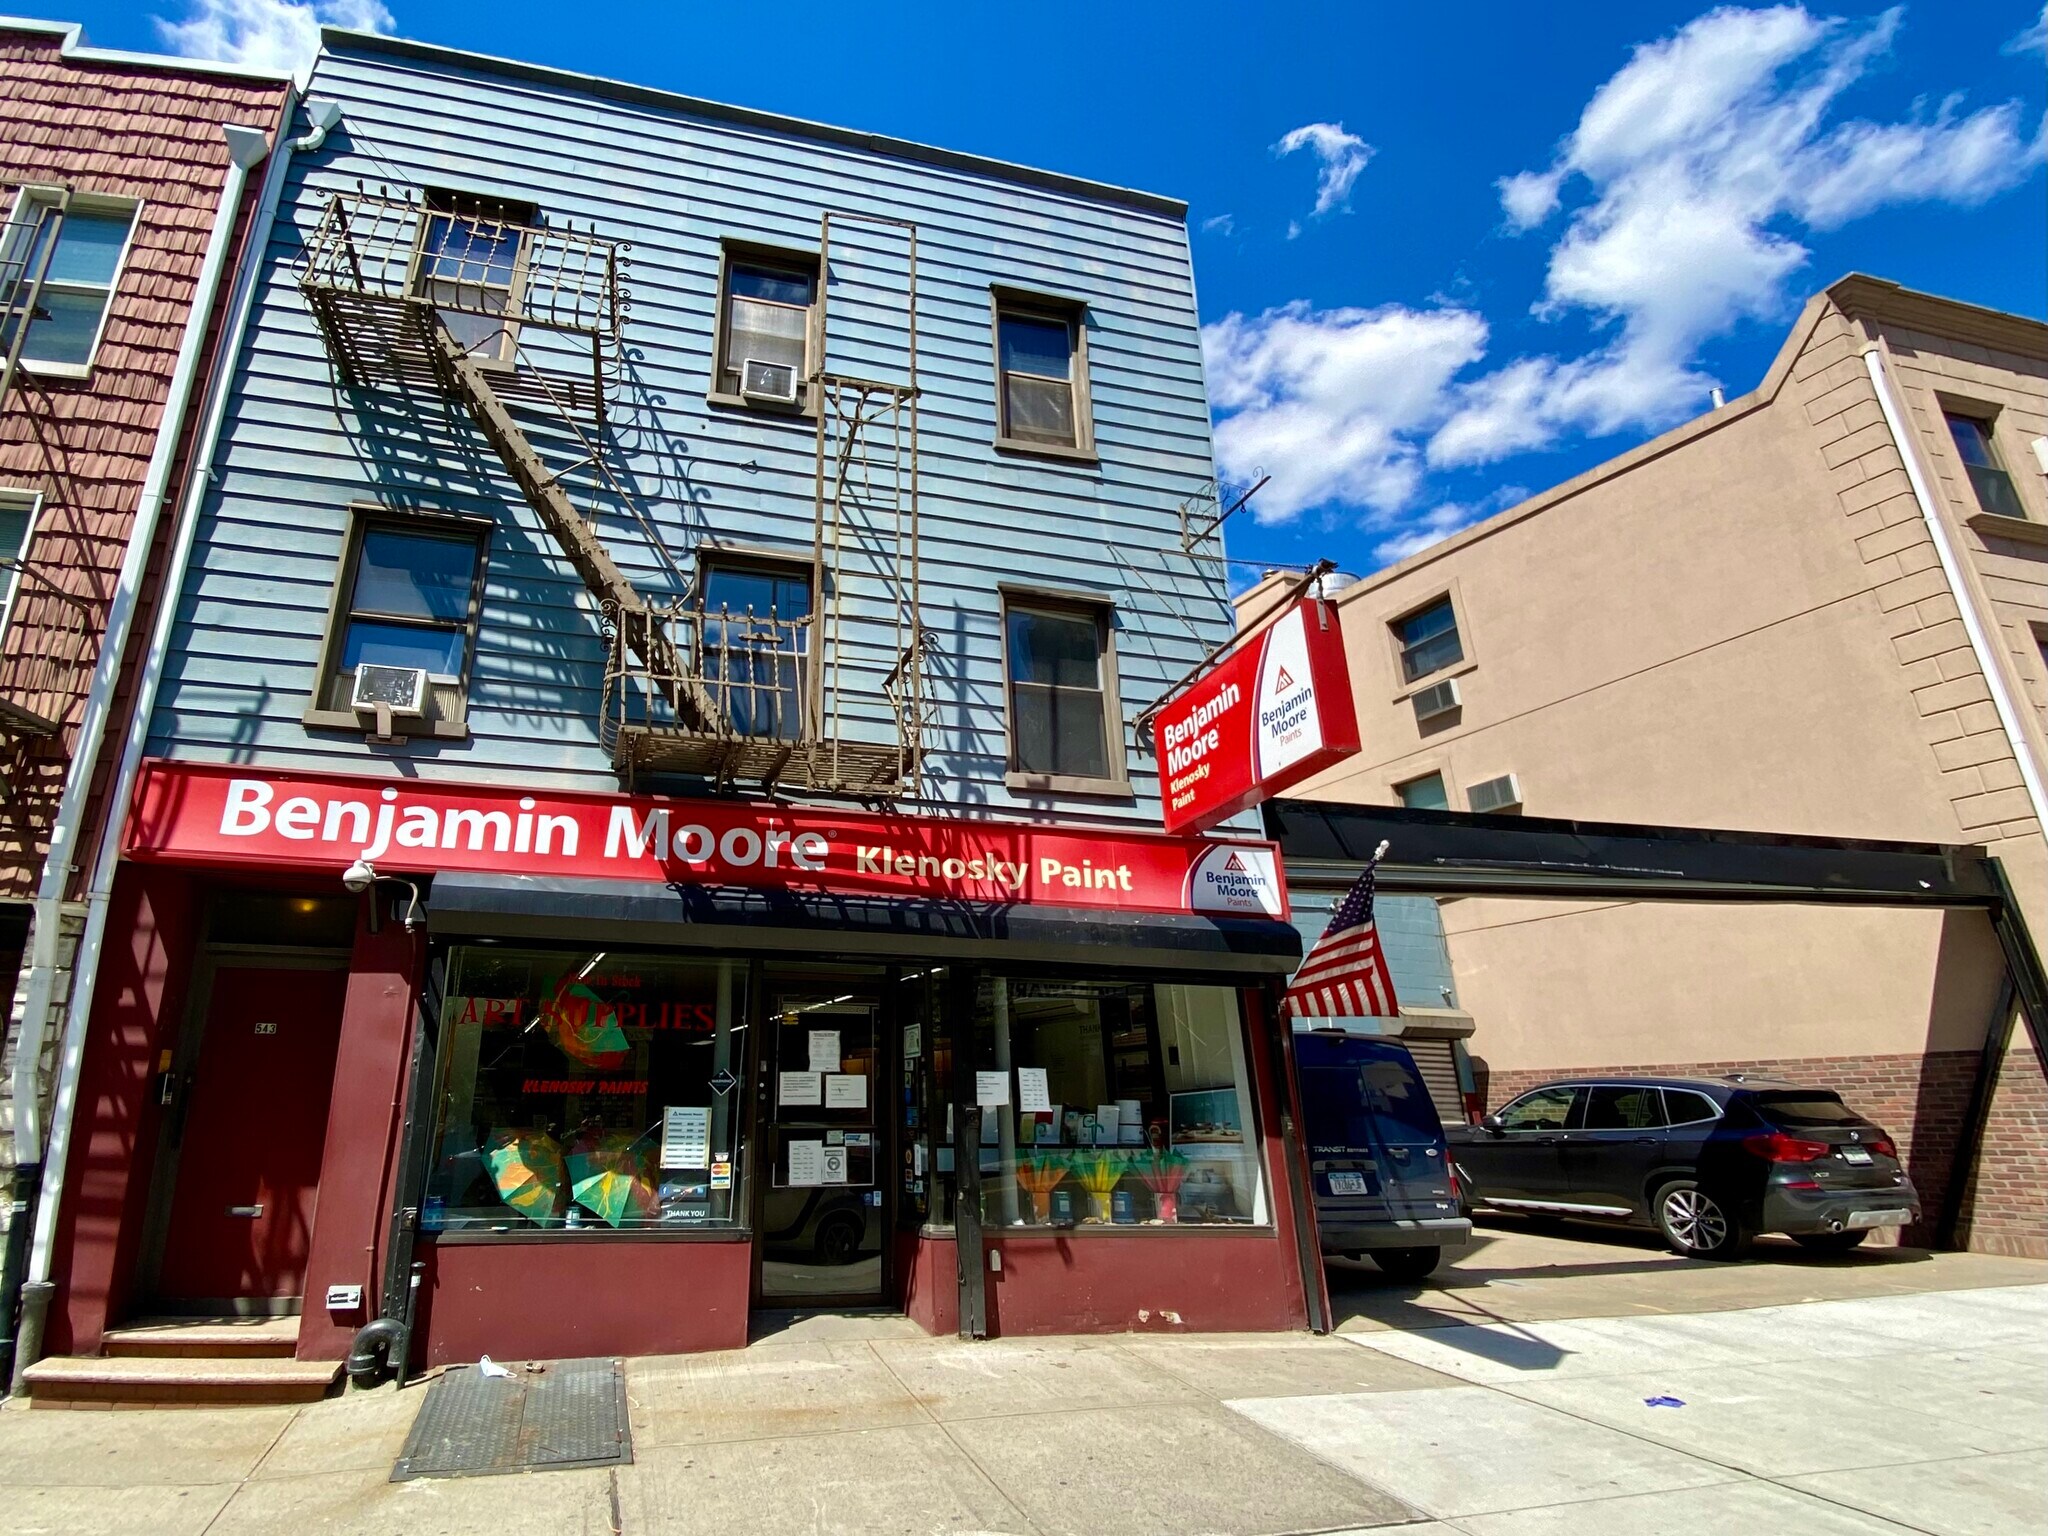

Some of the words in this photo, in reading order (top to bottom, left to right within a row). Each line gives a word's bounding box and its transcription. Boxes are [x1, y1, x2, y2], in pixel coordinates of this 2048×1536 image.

[1164, 682, 1240, 750] Benjamin
[1261, 687, 1313, 727] Benjamin
[1271, 709, 1307, 738] Moore
[1280, 728, 1303, 746] Paints
[1168, 730, 1219, 777] Moore
[1170, 762, 1210, 794] Klenosky
[1172, 789, 1196, 811] Paint
[219, 779, 580, 859] Benjamin
[604, 805, 828, 872] Moore
[856, 845, 1029, 890] Klenosky
[1040, 858, 1133, 892] Paint
[1206, 871, 1266, 887] Benjamin
[1217, 884, 1258, 898] Moore
[1227, 897, 1252, 907] Paints
[460, 995, 528, 1025] ART
[543, 997, 715, 1031] SUPPLIES
[256, 1024, 276, 1033] 543
[522, 1079, 595, 1095] KLENOSKY
[597, 1080, 648, 1095] PAINTS
[1312, 1145, 1346, 1153] TRANSIT
